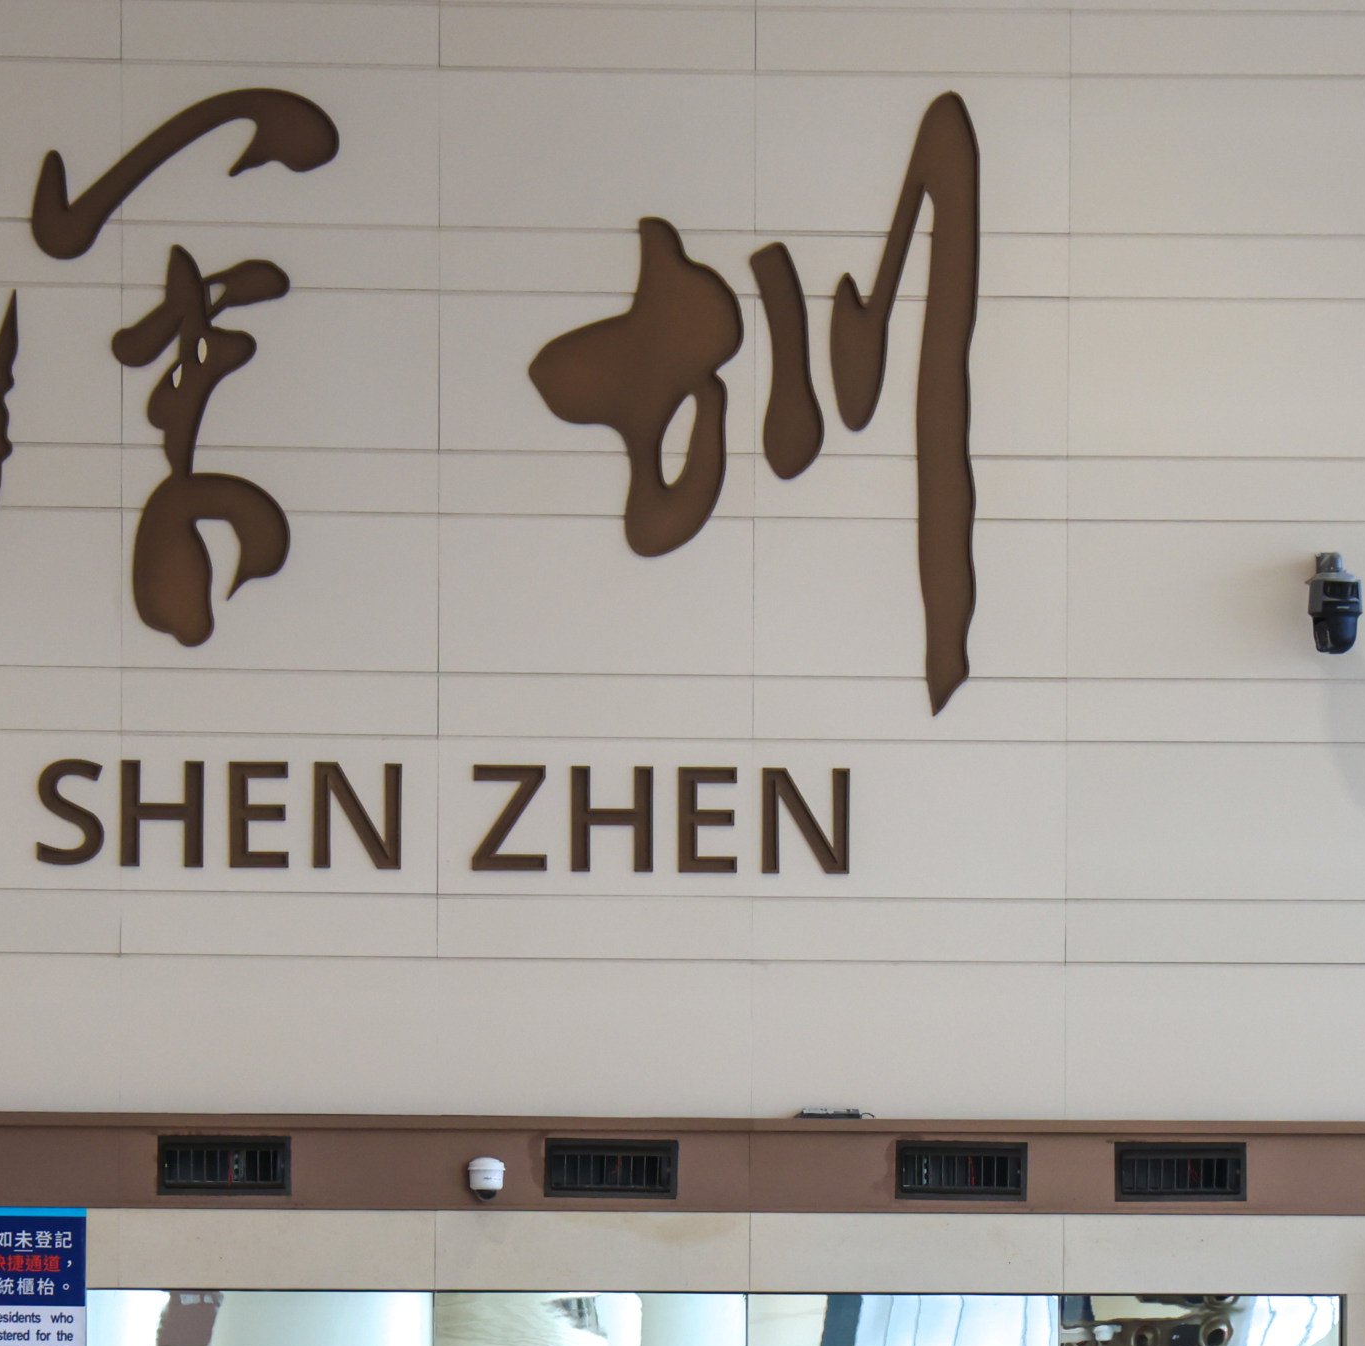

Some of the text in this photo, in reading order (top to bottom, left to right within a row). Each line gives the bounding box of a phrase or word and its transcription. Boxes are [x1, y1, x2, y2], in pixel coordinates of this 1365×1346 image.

[35, 757, 851, 874] SHEN ZHEN
[50, 1312, 74, 1324] who
[36, 1329, 52, 1342] for
[57, 1330, 74, 1342] the
